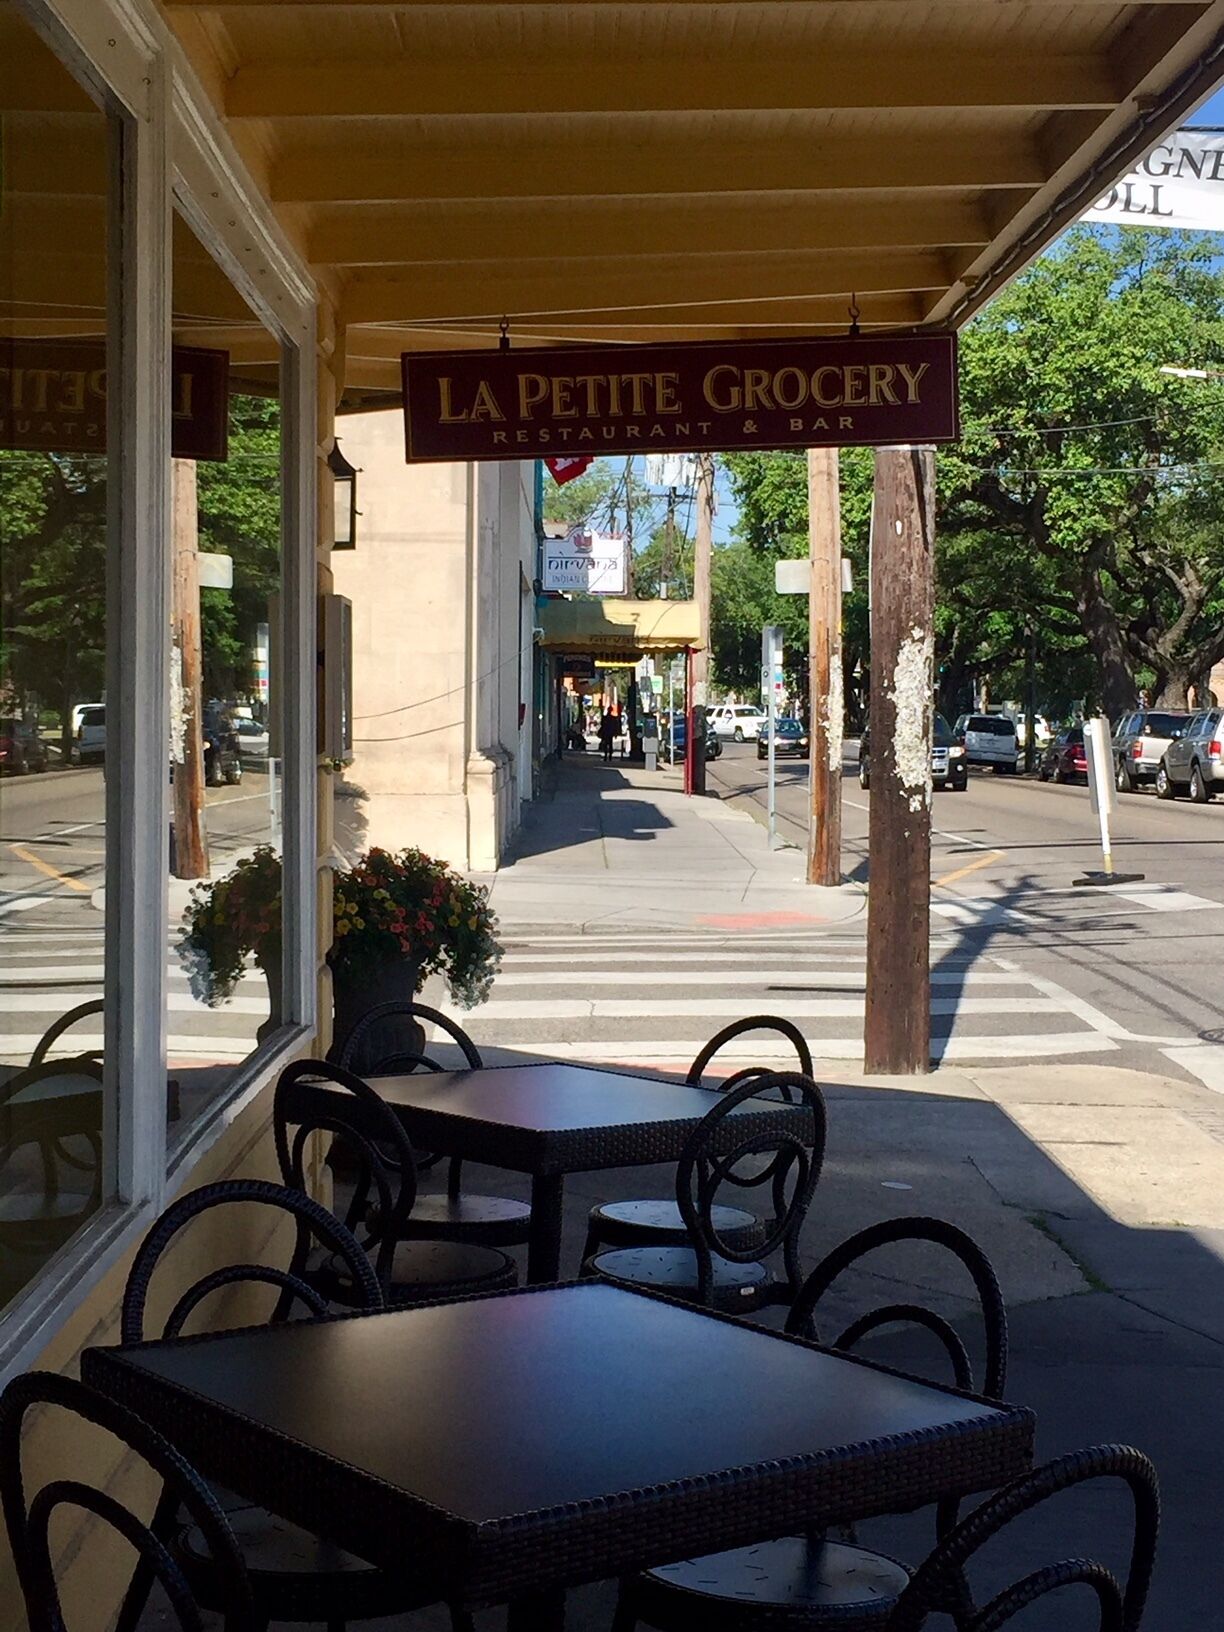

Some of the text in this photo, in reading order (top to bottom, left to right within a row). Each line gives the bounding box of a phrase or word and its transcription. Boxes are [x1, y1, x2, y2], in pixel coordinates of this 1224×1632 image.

[1126, 145, 1224, 181] GNE
[437, 361, 931, 424] LA PETITE GROCERY
[492, 415, 856, 445] RESTAURANT & BAR
[547, 551, 619, 570] nirvana
